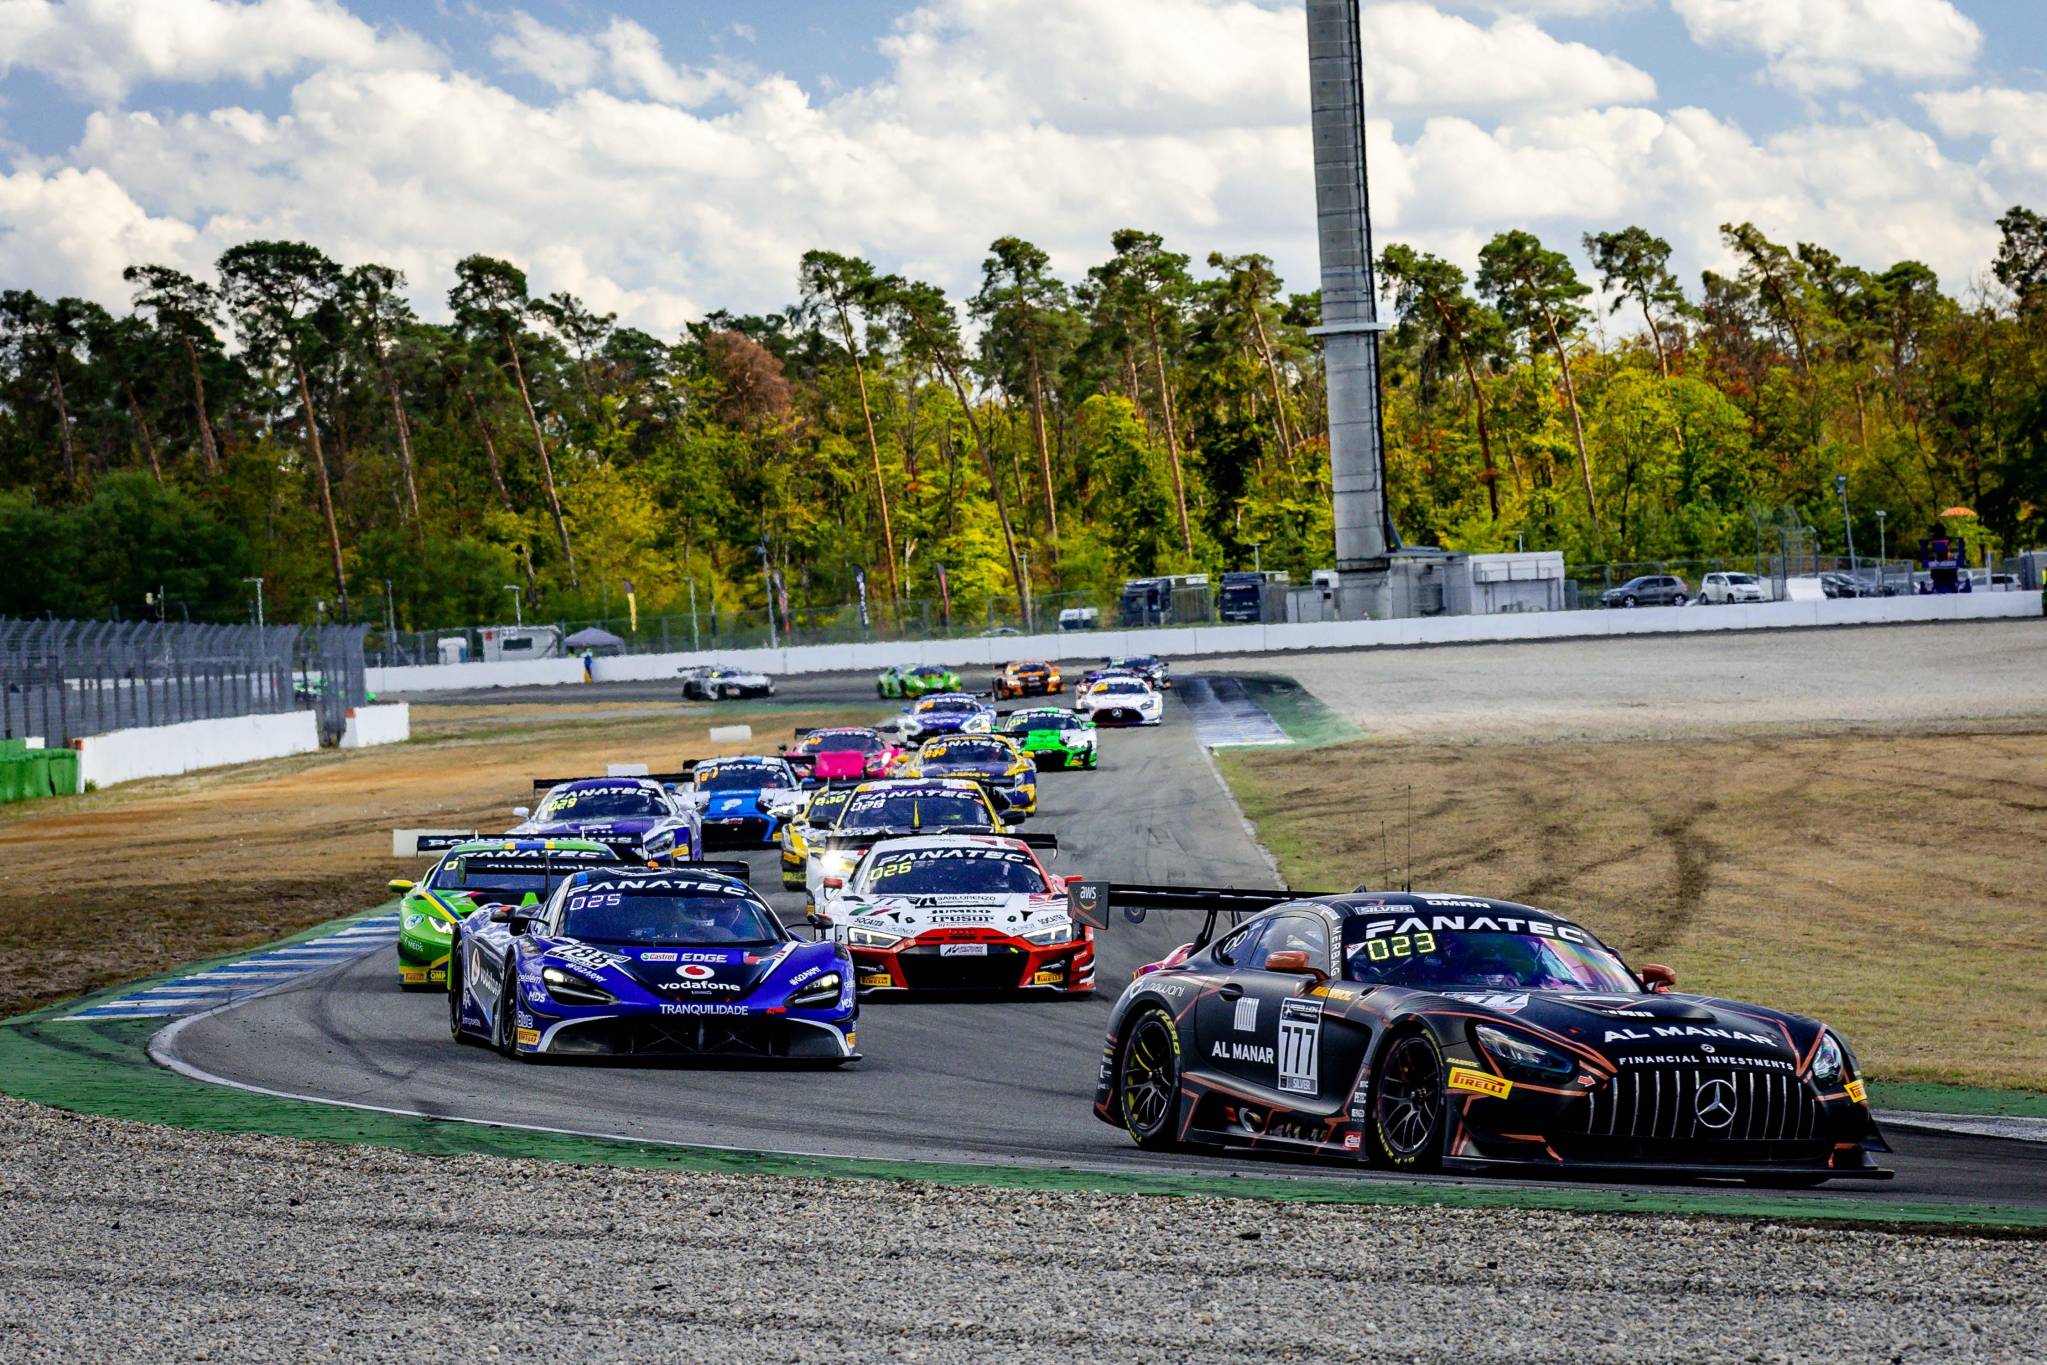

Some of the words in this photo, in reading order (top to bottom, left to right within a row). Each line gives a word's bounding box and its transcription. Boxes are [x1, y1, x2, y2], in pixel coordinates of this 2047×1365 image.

[555, 787, 652, 799] FANATEC
[855, 790, 979, 802] FANATEC
[878, 849, 1028, 867] FANATEC
[869, 860, 912, 881] 026
[567, 879, 749, 899] FANATEC
[1080, 885, 1097, 900] aws
[1359, 905, 1411, 914] SILVER
[1426, 899, 1492, 909] OMAN
[1365, 915, 1585, 944] FANATEC
[1330, 925, 1342, 977] MERBAG
[1366, 931, 1437, 962] 023
[649, 952, 676, 961] Castrol
[681, 953, 728, 963] EDGE
[657, 980, 741, 992] vodafone
[528, 991, 547, 1003] MDS
[659, 1003, 749, 1016] TRANQUILIDADE
[1604, 1028, 1651, 1043] AL
[1652, 1025, 1779, 1048] MANAR
[1211, 1040, 1230, 1059] AL
[1232, 1043, 1275, 1065] MANAR
[1281, 1025, 1316, 1076] 777
[1618, 1055, 1700, 1066] FINANCIAL
[1705, 1055, 1795, 1071] INVESTMENTS
[1453, 1071, 1506, 1094] PIRELLI
